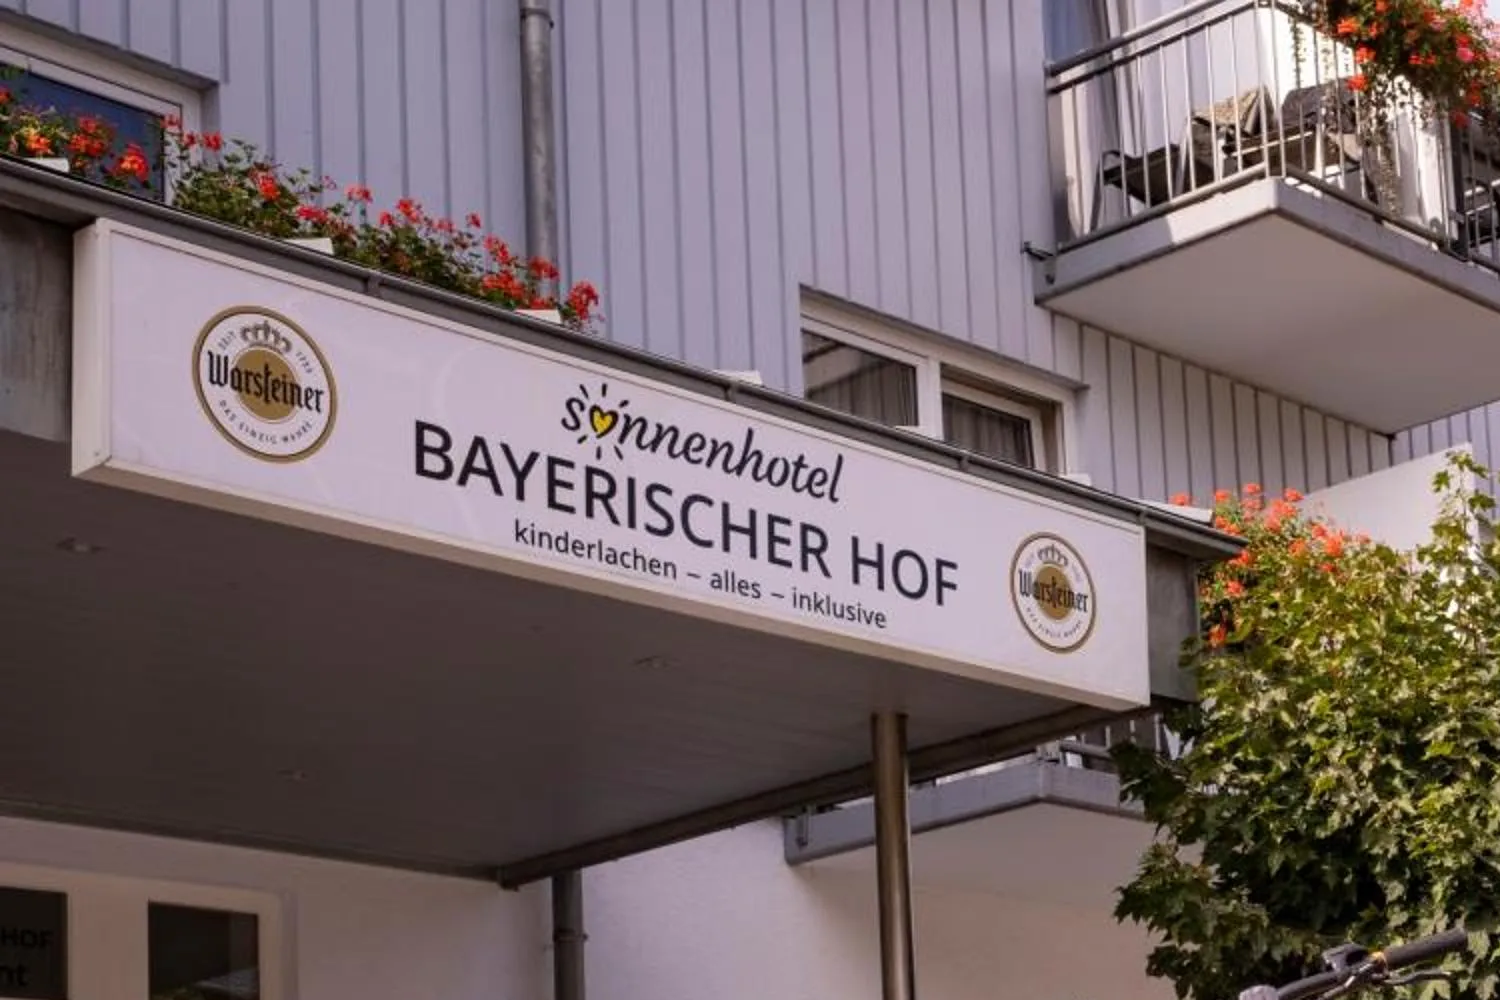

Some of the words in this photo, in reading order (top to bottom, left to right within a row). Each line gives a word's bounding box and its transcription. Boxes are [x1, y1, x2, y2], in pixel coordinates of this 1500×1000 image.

[207, 349, 324, 413] Warsteiner
[415, 419, 832, 579] BAYERISCHER
[851, 535, 958, 606] HOF
[514, 518, 677, 580] kinderlachen
[710, 570, 761, 599] alles
[792, 588, 886, 629] inklusive
[1019, 568, 1088, 613] Warsteiner
